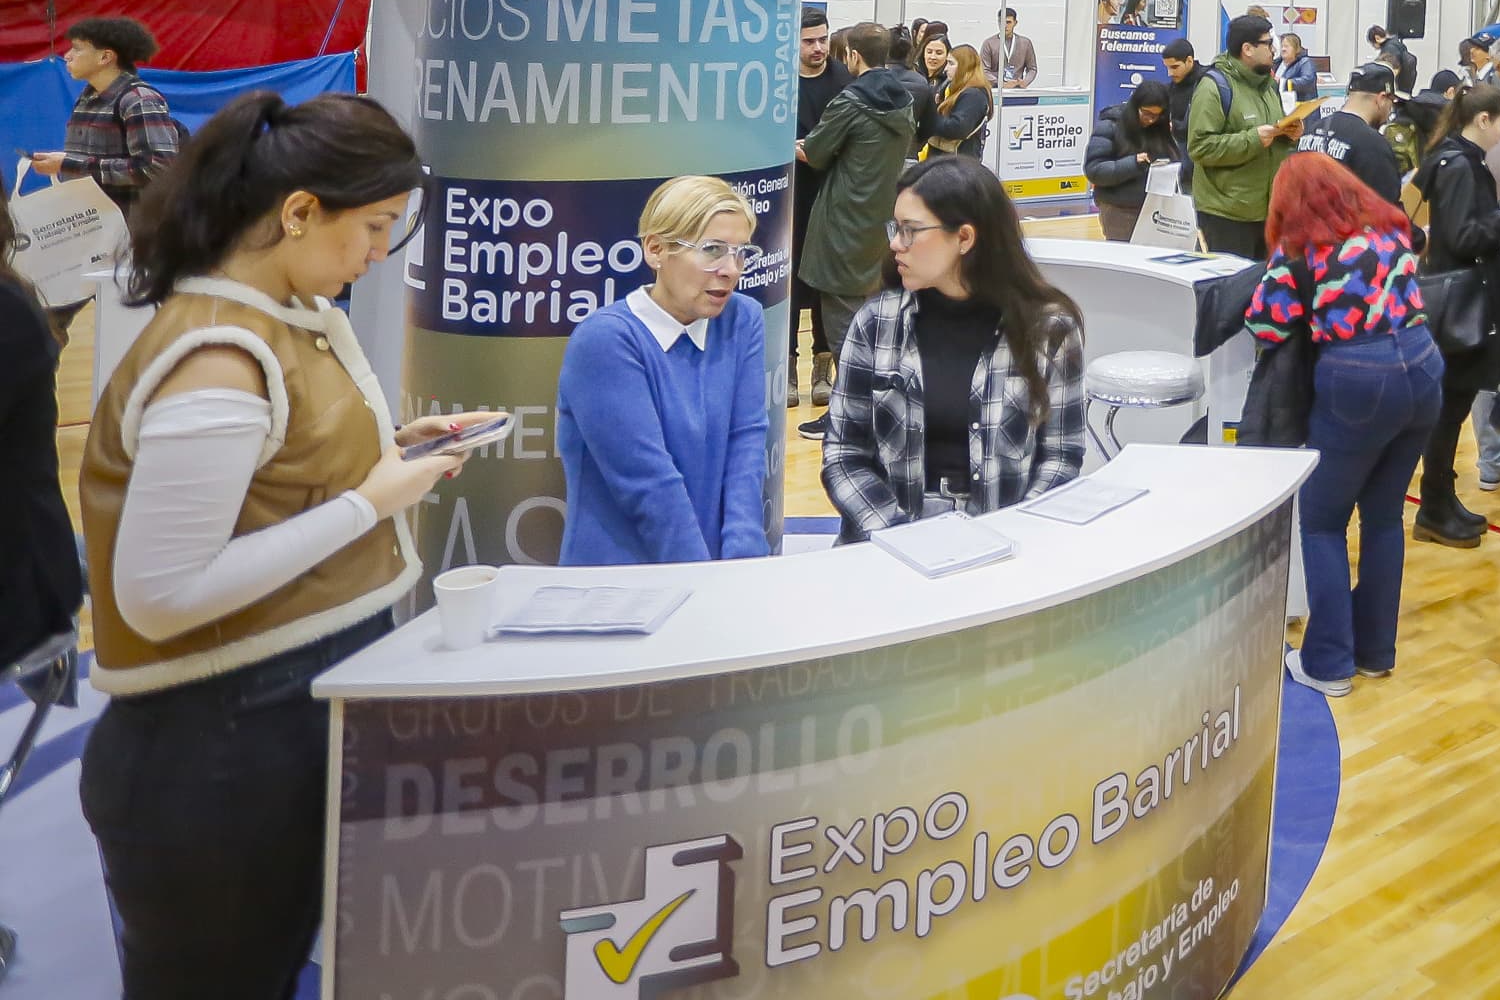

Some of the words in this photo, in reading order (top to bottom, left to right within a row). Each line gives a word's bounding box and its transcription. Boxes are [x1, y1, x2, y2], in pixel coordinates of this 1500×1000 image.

[1100, 29, 1156, 40] Buscamos
[1100, 41, 1165, 53] Telemarkete
[1037, 115, 1065, 126] Expo
[1321, 106, 1337, 114] xpo
[1037, 124, 1083, 138] Empleo
[1037, 136, 1076, 149] Barrial
[757, 173, 789, 194] General
[446, 188, 554, 234] Expo
[443, 231, 644, 284] Empleo
[738, 270, 774, 290] Trabajo
[441, 278, 615, 324] Barrial
[382, 704, 884, 841] DESERROLLO
[765, 812, 1080, 969] Empleo
[1092, 683, 1241, 845] Barrial
[769, 790, 970, 886] Expo
[1063, 901, 1189, 1000] Secretaría
[1191, 876, 1213, 913] de
[1161, 946, 1175, 981] y
[1178, 877, 1240, 961] Empleo
